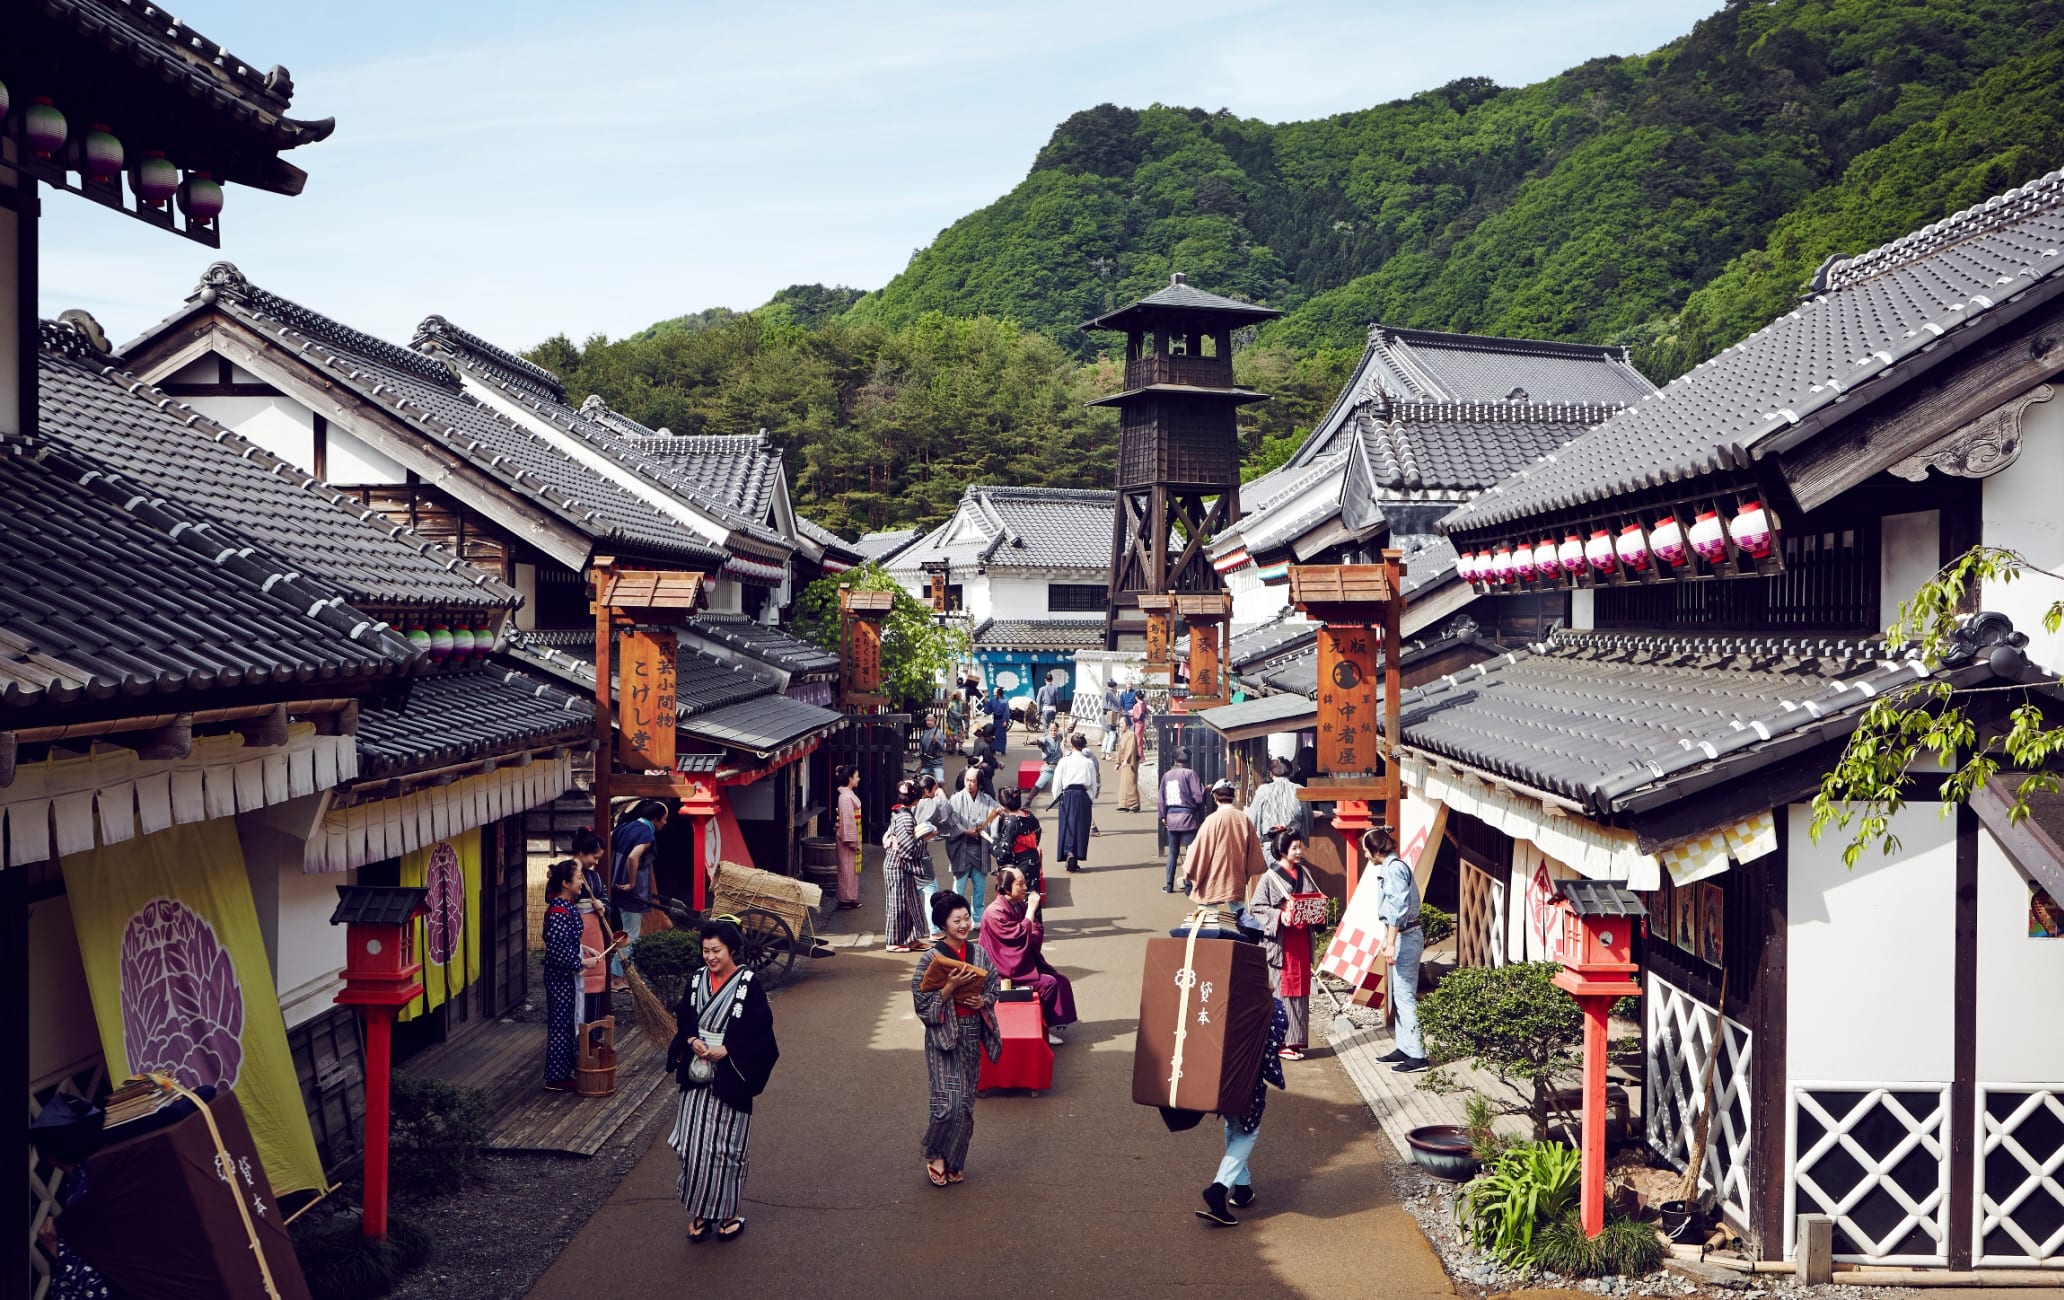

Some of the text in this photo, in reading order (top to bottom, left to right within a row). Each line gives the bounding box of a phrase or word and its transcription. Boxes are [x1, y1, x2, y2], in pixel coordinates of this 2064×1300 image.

[631, 660, 652, 752] こけし堂
[656, 642, 674, 728] 民芸小間物
[1197, 980, 1213, 1025] 貸本
